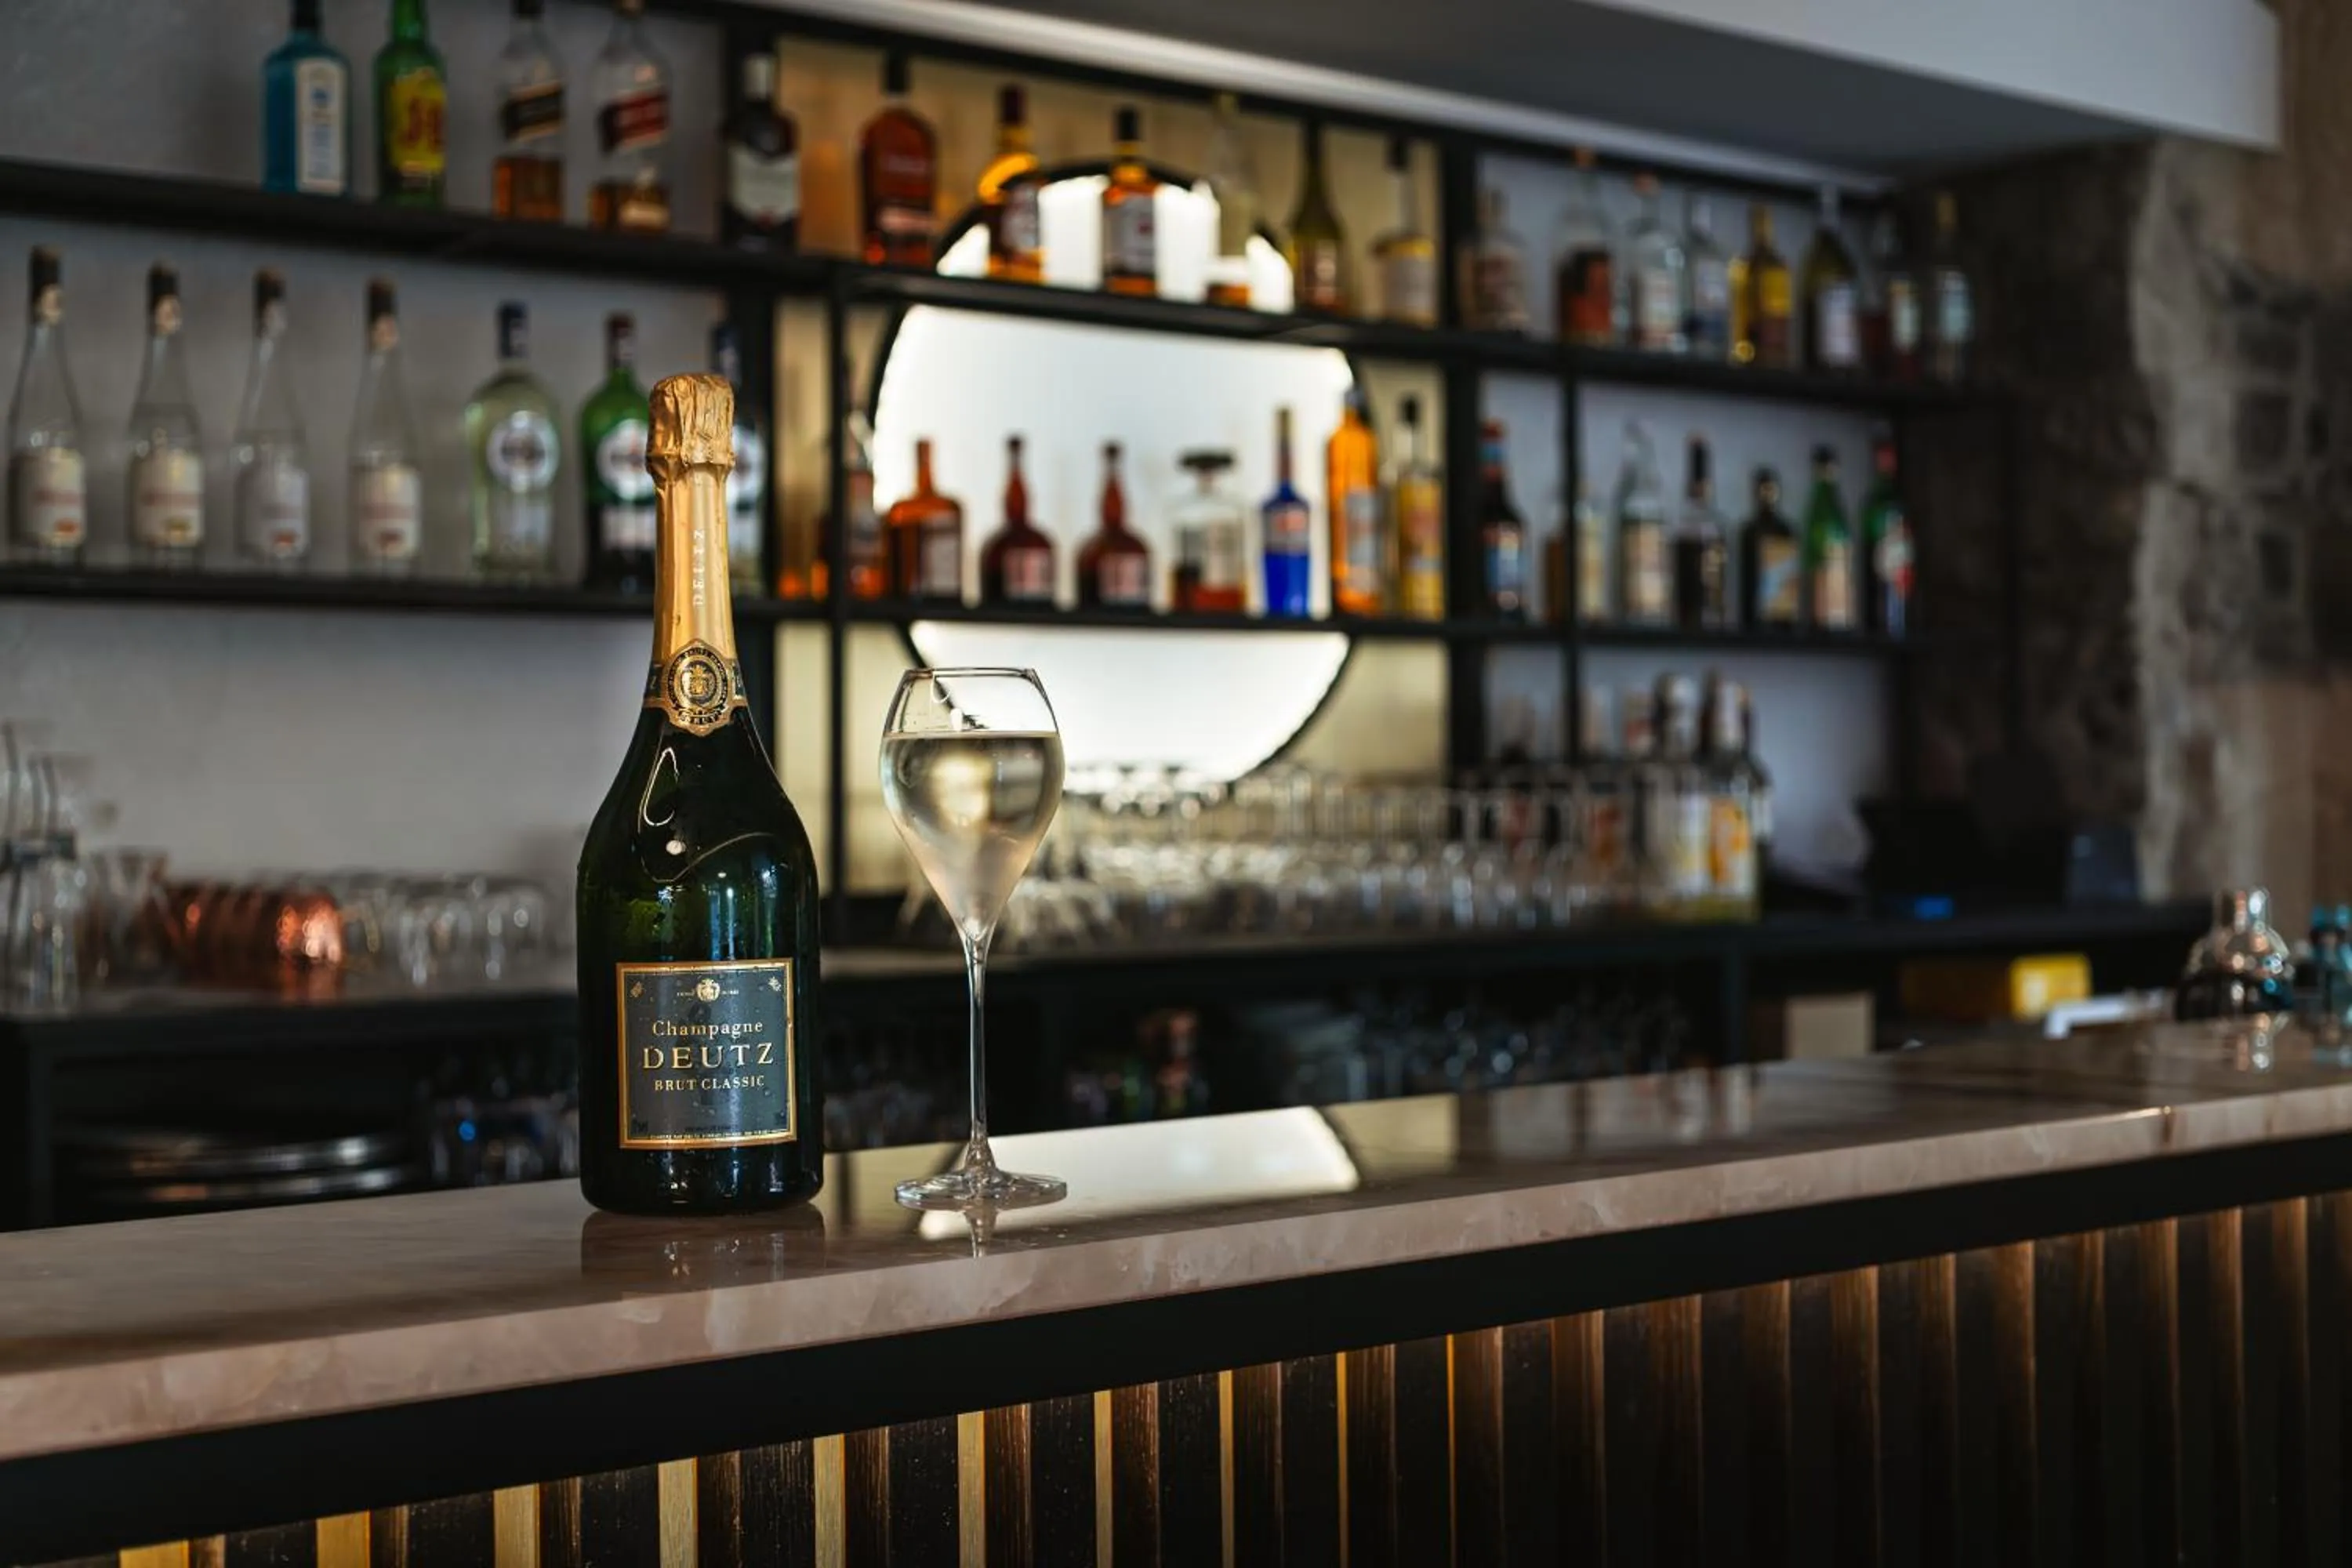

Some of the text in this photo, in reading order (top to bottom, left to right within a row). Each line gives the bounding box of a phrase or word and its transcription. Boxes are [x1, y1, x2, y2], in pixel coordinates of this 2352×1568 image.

[652, 1020, 763, 1040] Champagne
[643, 1042, 774, 1069] DEUTZ
[655, 1075, 764, 1091] BRUT CLASSIC
